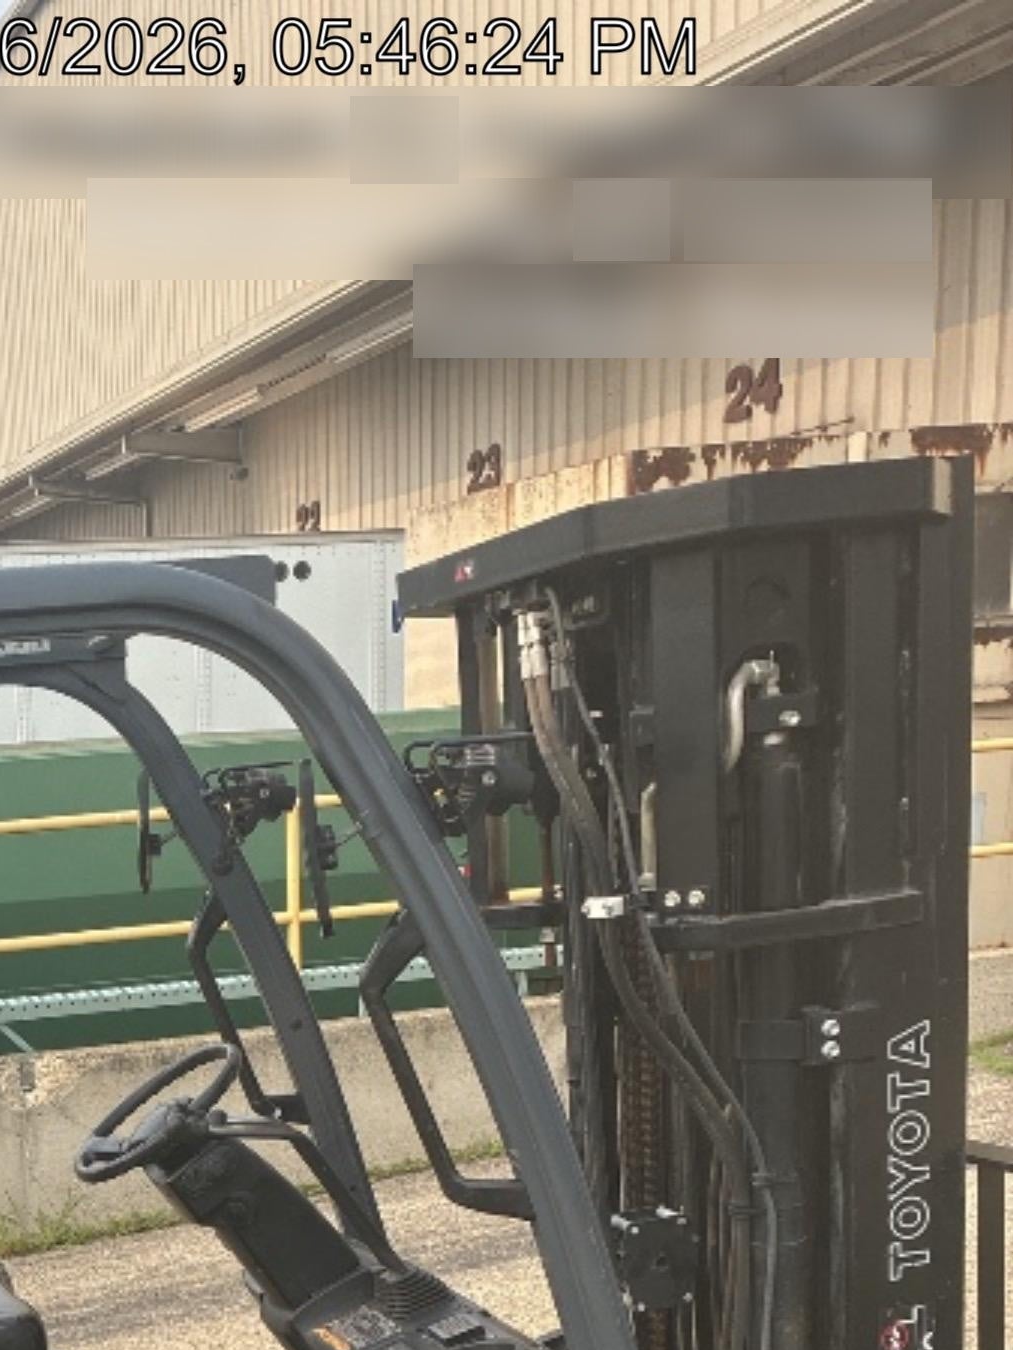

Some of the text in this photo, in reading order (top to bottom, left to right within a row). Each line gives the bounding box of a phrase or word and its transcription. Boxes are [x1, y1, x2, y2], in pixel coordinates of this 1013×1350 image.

[723, 358, 782, 424] 24
[466, 443, 500, 496] 23
[887, 1019, 931, 1282] TOYOTA
